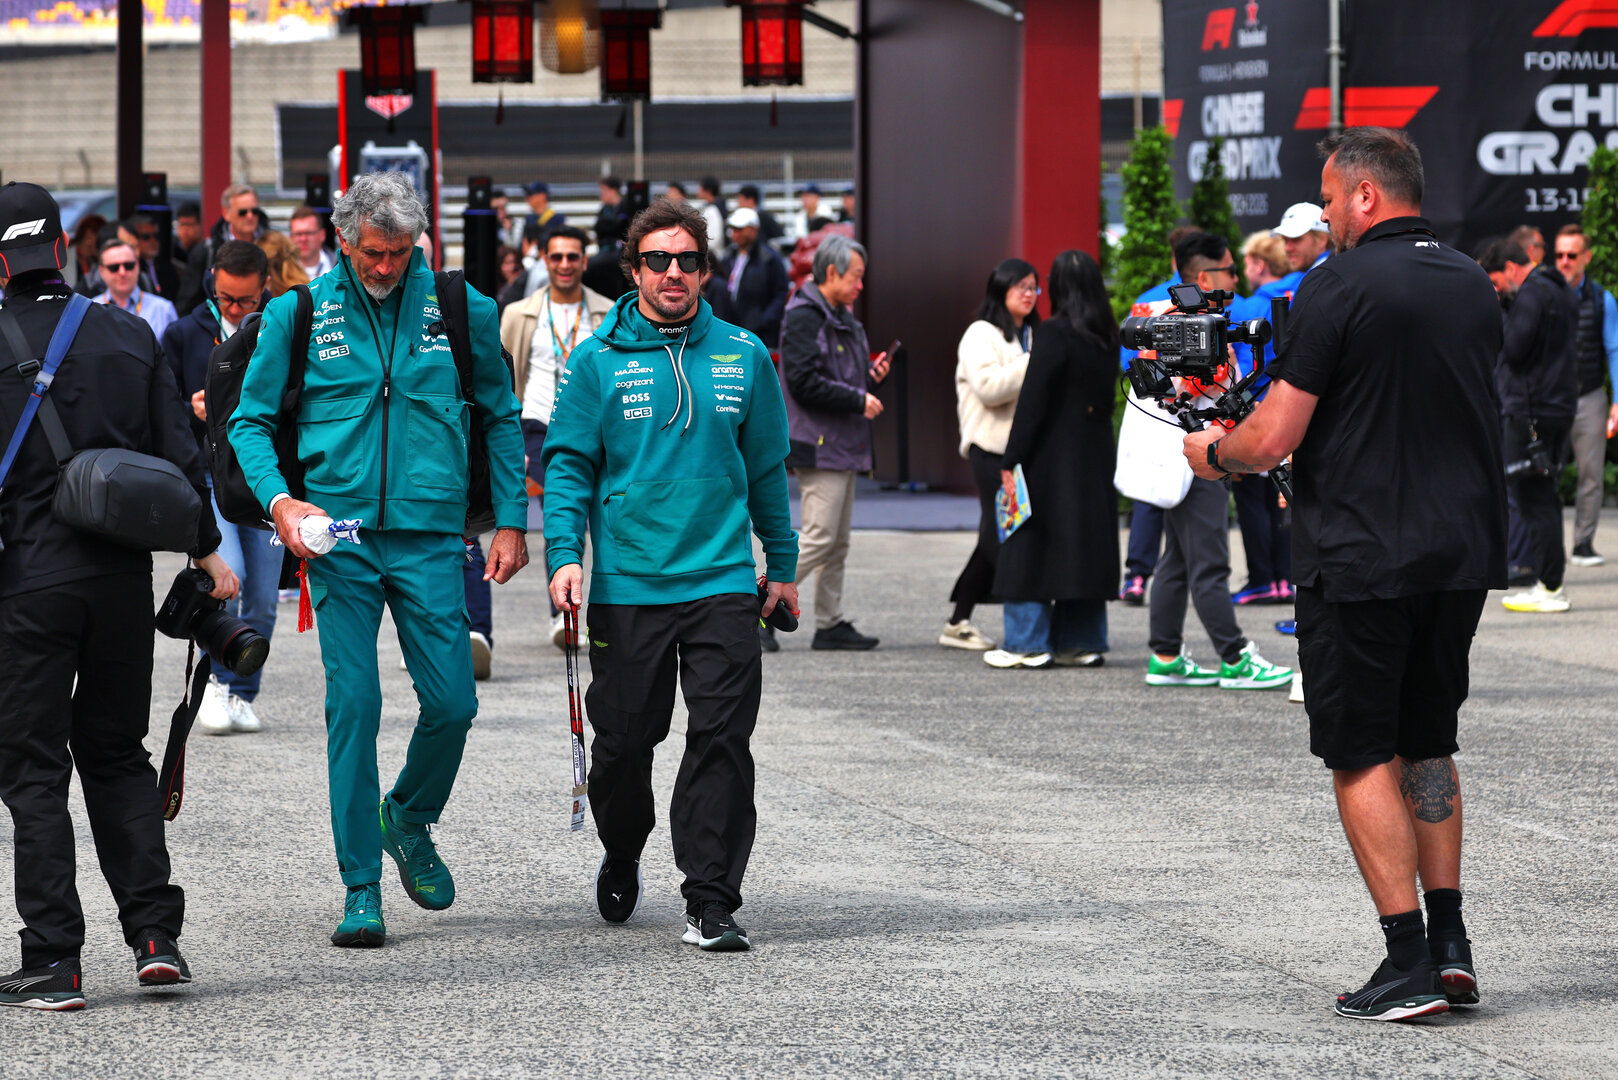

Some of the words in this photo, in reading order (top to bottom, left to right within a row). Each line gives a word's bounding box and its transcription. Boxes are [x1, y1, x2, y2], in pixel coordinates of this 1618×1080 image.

[1535, 83, 1618, 128] CH
[1240, 136, 1282, 180] PRIX
[1477, 130, 1618, 175] GRA
[0, 219, 46, 241] F1
[315, 331, 344, 345] BOSS
[319, 346, 349, 360] JCB
[615, 367, 653, 377] MAADEN
[616, 378, 654, 389] cognizant
[622, 393, 650, 404] BOSS
[624, 407, 652, 420] JCB
